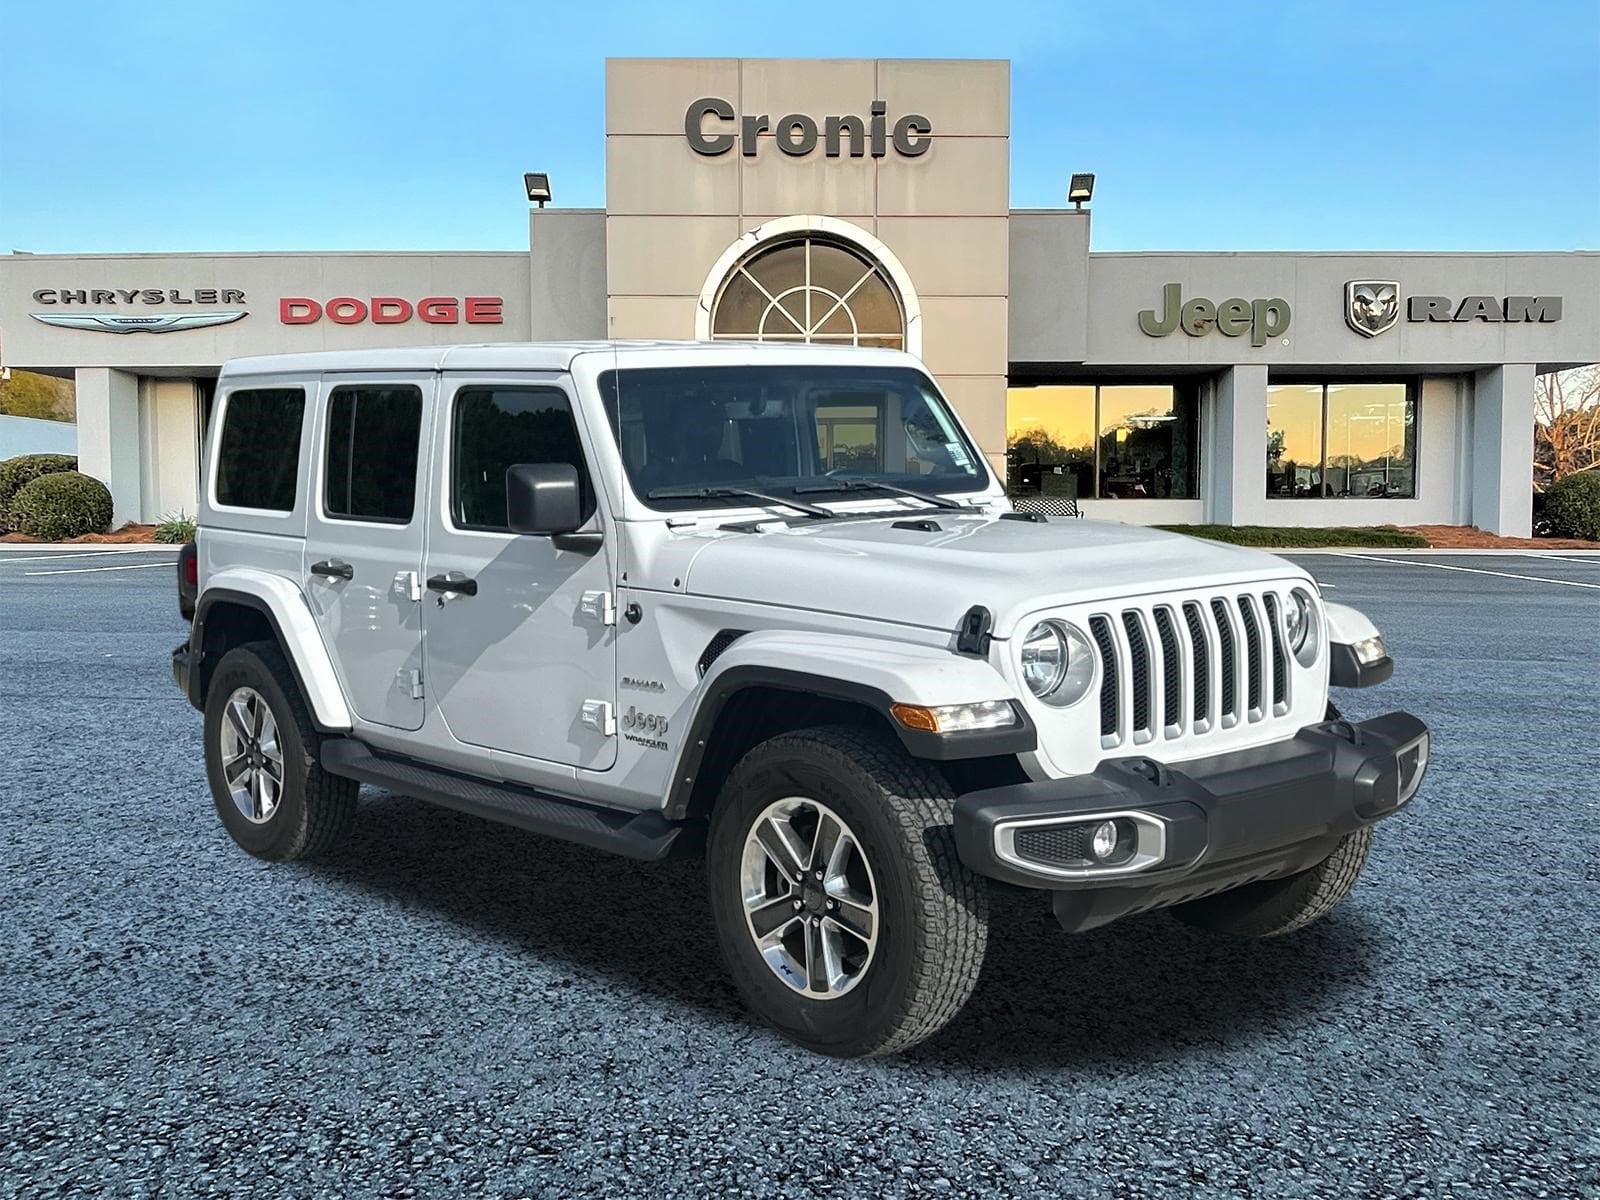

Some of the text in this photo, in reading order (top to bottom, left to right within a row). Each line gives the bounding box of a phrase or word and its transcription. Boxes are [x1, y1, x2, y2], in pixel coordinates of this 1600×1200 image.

[685, 97, 932, 157] Cronic
[32, 289, 246, 305] CHRYSLER
[280, 297, 503, 325] DODGE
[1407, 296, 1562, 322] RAM
[1138, 283, 1291, 347] Jeep
[622, 705, 669, 737] Jeep
